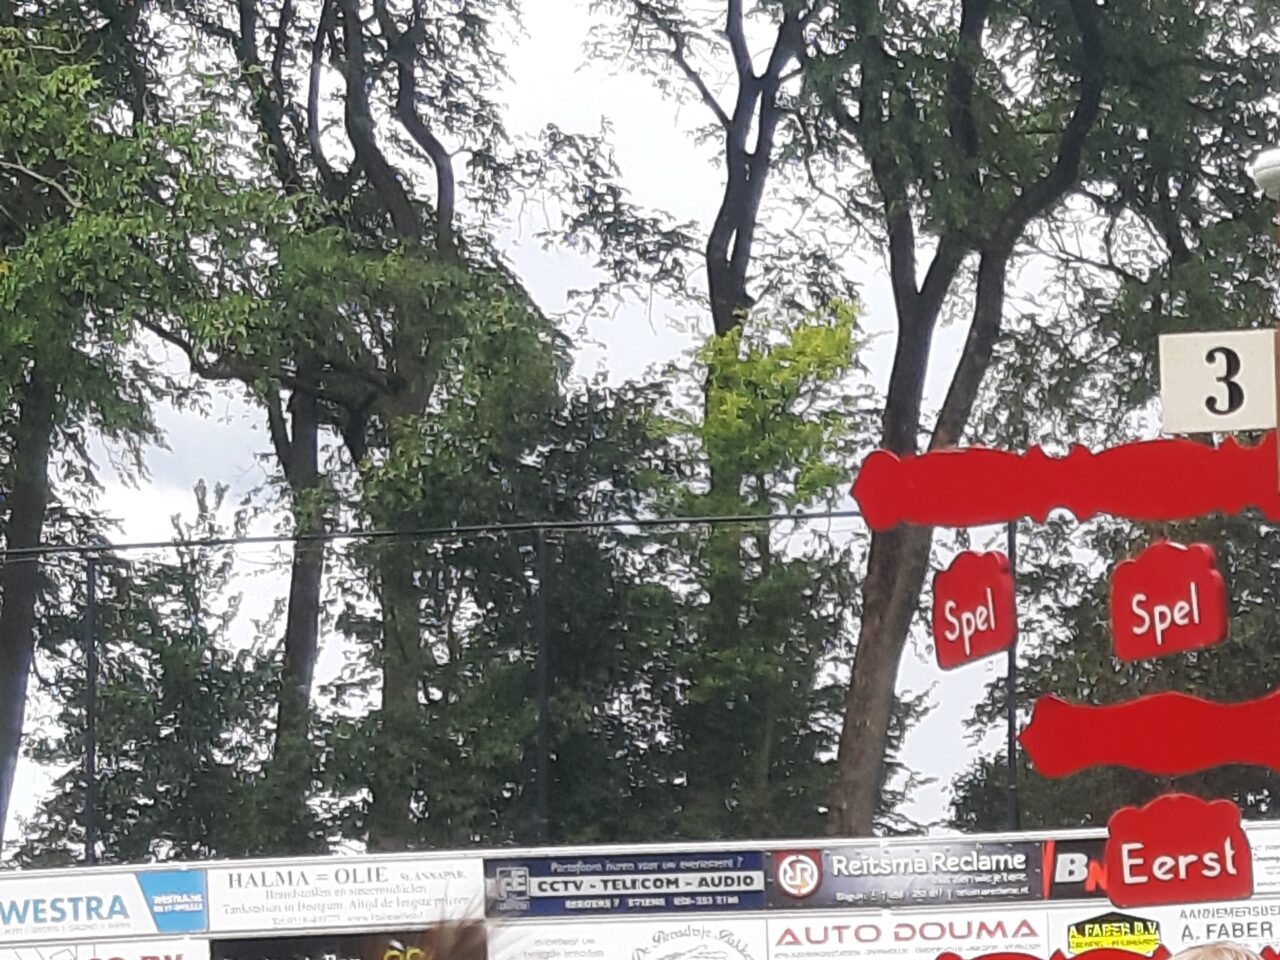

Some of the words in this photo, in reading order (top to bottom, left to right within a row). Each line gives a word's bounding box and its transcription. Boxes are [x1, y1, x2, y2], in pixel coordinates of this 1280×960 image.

[1203, 346, 1246, 416] 3
[943, 588, 996, 653] Spel
[1132, 582, 1200, 645] Spel
[832, 854, 928, 877] Reitsma
[931, 851, 1027, 872] Reclame
[1121, 835, 1237, 884] Eerst
[227, 869, 310, 889] HALMA
[334, 866, 389, 885] OLIE
[537, 880, 585, 893] CCTV
[697, 875, 755, 888] AUDIO
[0, 894, 131, 926] WESTRA
[775, 923, 882, 947] AUTO
[894, 918, 1039, 943] DOUMA
[1206, 921, 1274, 940] FABER
